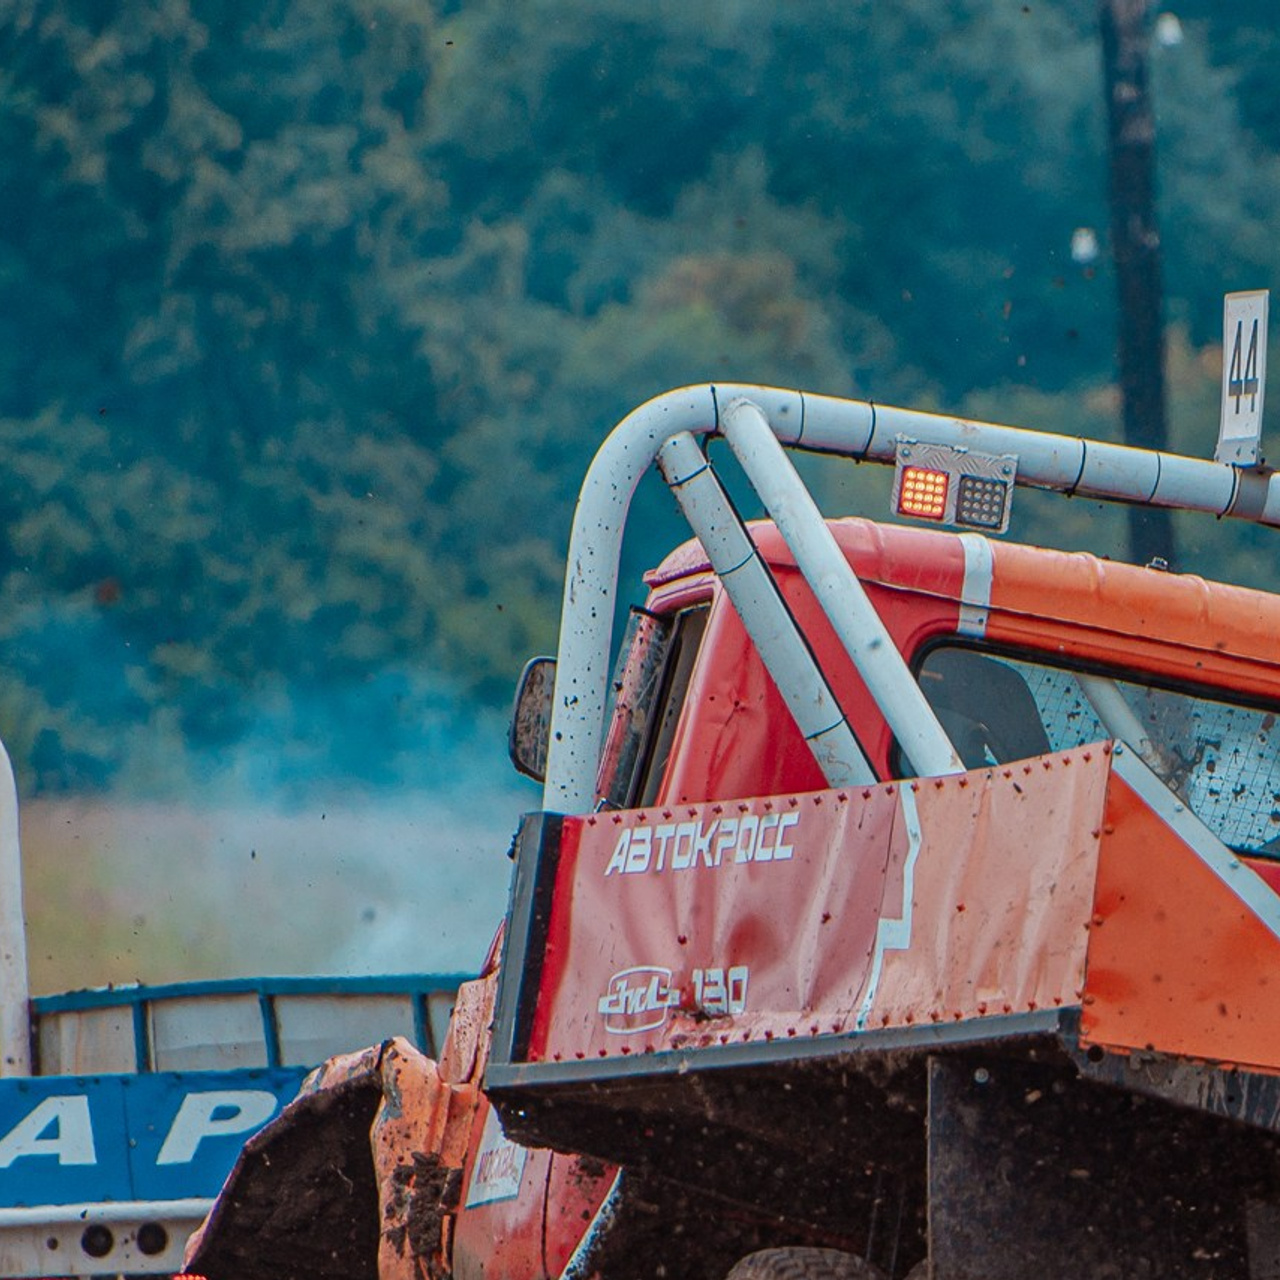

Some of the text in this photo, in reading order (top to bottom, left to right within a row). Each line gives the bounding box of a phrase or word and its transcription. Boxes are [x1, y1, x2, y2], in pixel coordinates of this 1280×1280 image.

[1229, 319, 1258, 415] 44
[603, 811, 800, 876] АВТОКРОСС
[691, 965, 749, 1015] 130
